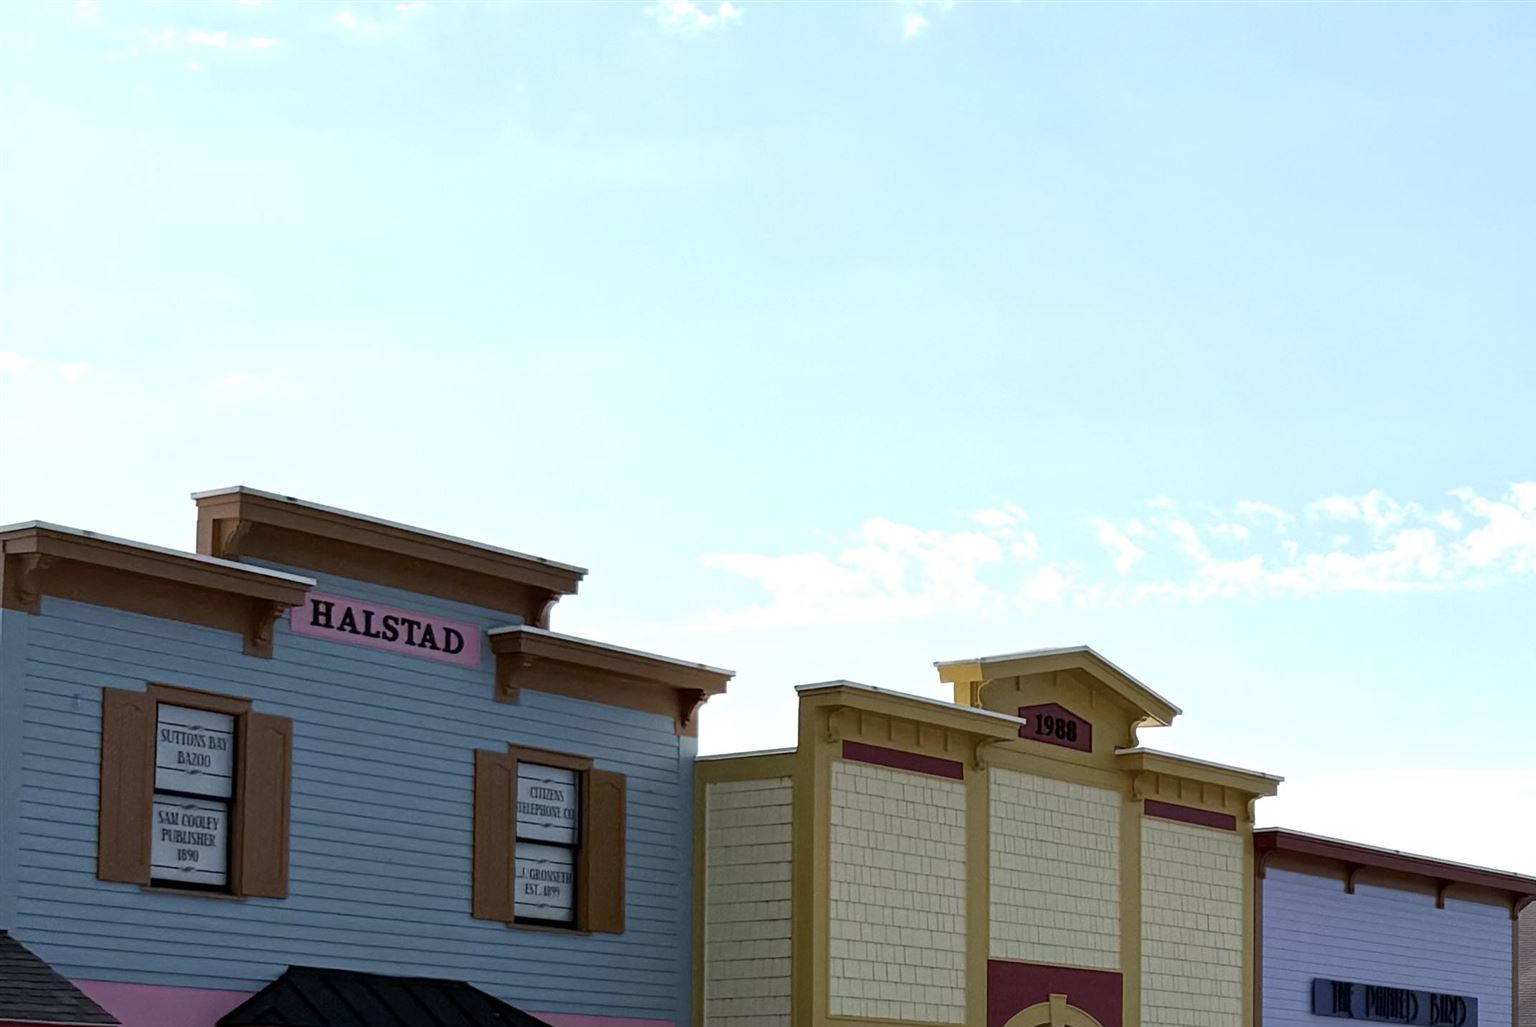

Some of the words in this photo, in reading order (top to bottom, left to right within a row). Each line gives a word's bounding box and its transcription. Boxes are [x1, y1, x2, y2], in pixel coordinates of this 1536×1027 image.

[310, 599, 464, 655] HALSTAD
[1035, 713, 1077, 742] 1988
[161, 729, 206, 748] SUTTONS
[208, 736, 229, 751] BAY
[177, 751, 211, 768] BAZOO
[530, 786, 565, 802] CITIZENS
[158, 811, 179, 826] SAM
[181, 814, 219, 831] COOLEY
[161, 828, 216, 847] PUBLISHER
